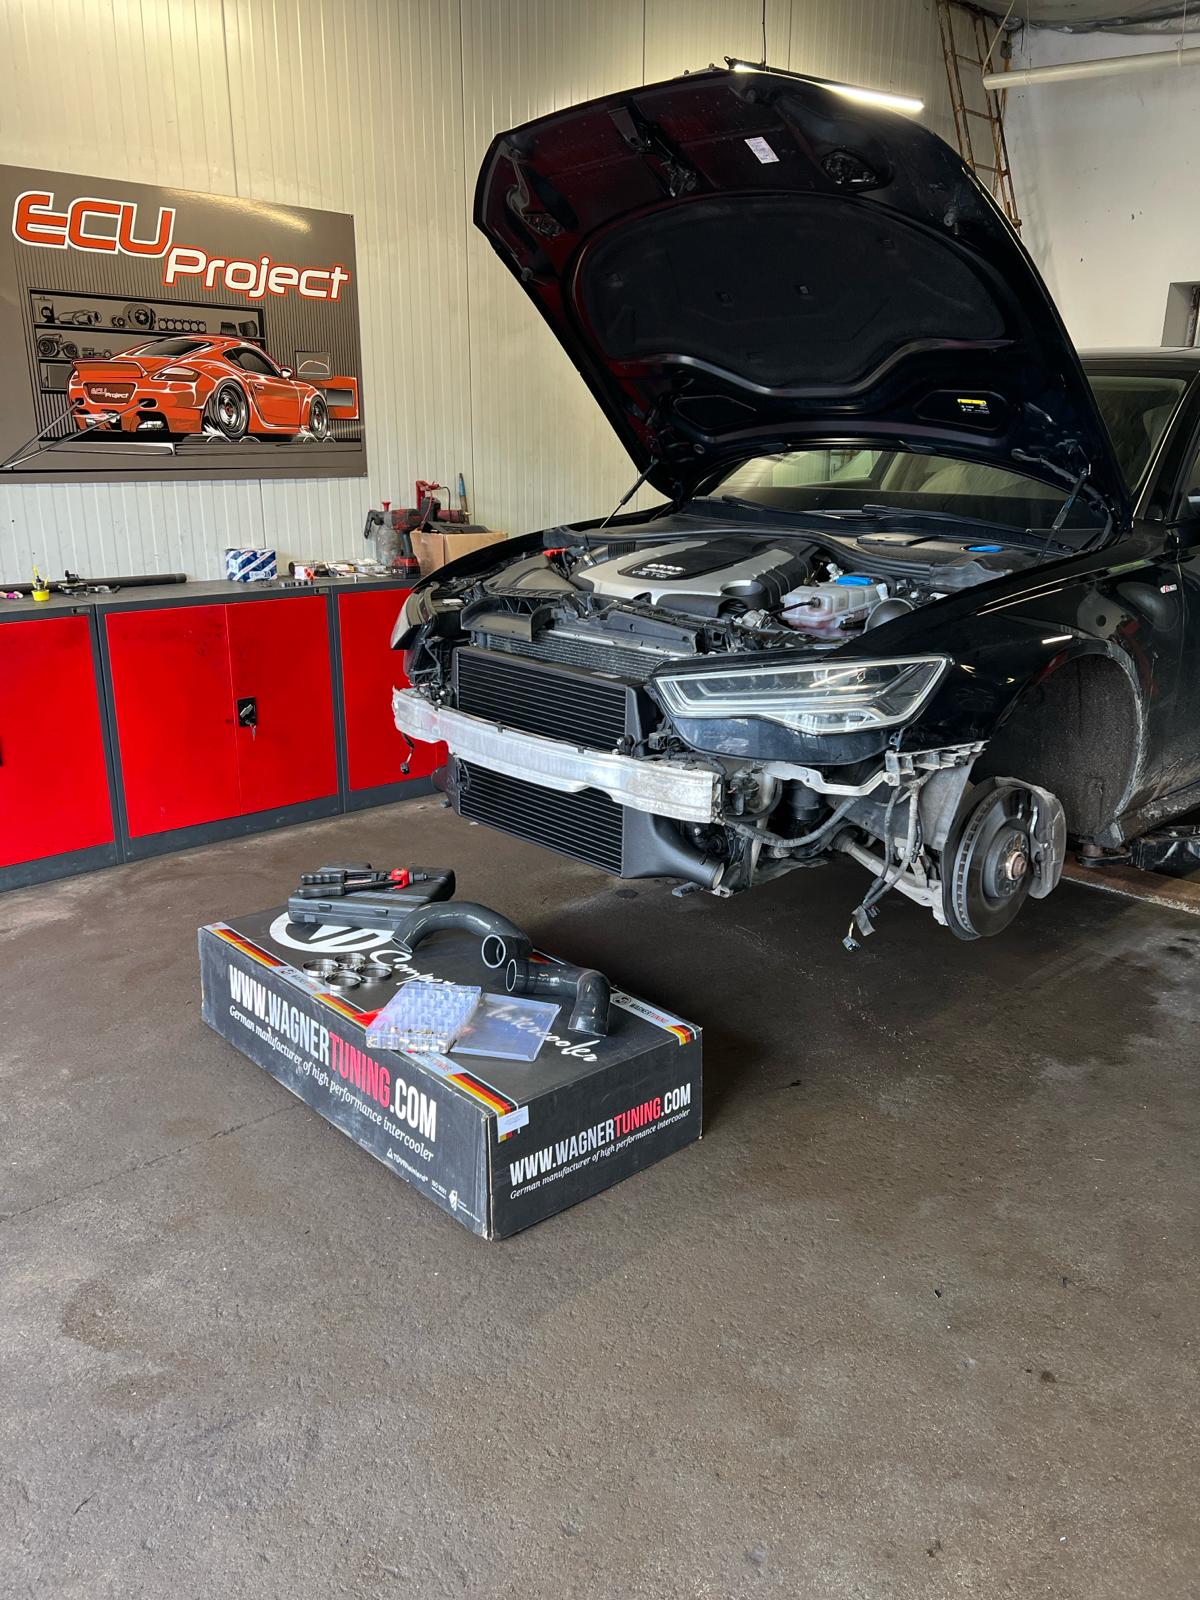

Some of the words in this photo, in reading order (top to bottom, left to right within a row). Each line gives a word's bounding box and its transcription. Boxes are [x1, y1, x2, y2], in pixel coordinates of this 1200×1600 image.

[12, 190, 176, 258] ECU
[163, 246, 349, 300] Project
[229, 964, 437, 1143] WWW.WAGNERTUNING.COM
[229, 1005, 255, 1032] German
[255, 1025, 302, 1065] manufacturer
[302, 1061, 313, 1076] of
[312, 1063, 329, 1087] high
[329, 1080, 383, 1126] performance
[383, 1116, 435, 1162] intercooler
[510, 1083, 691, 1187] WWW.WAGNERTUNING.COM
[510, 1180, 541, 1200] German
[542, 1156, 591, 1185] manufacturer
[592, 1150, 601, 1163] of
[600, 1144, 615, 1158] high
[615, 1125, 656, 1152] performance
[656, 1109, 690, 1131] intercooler
